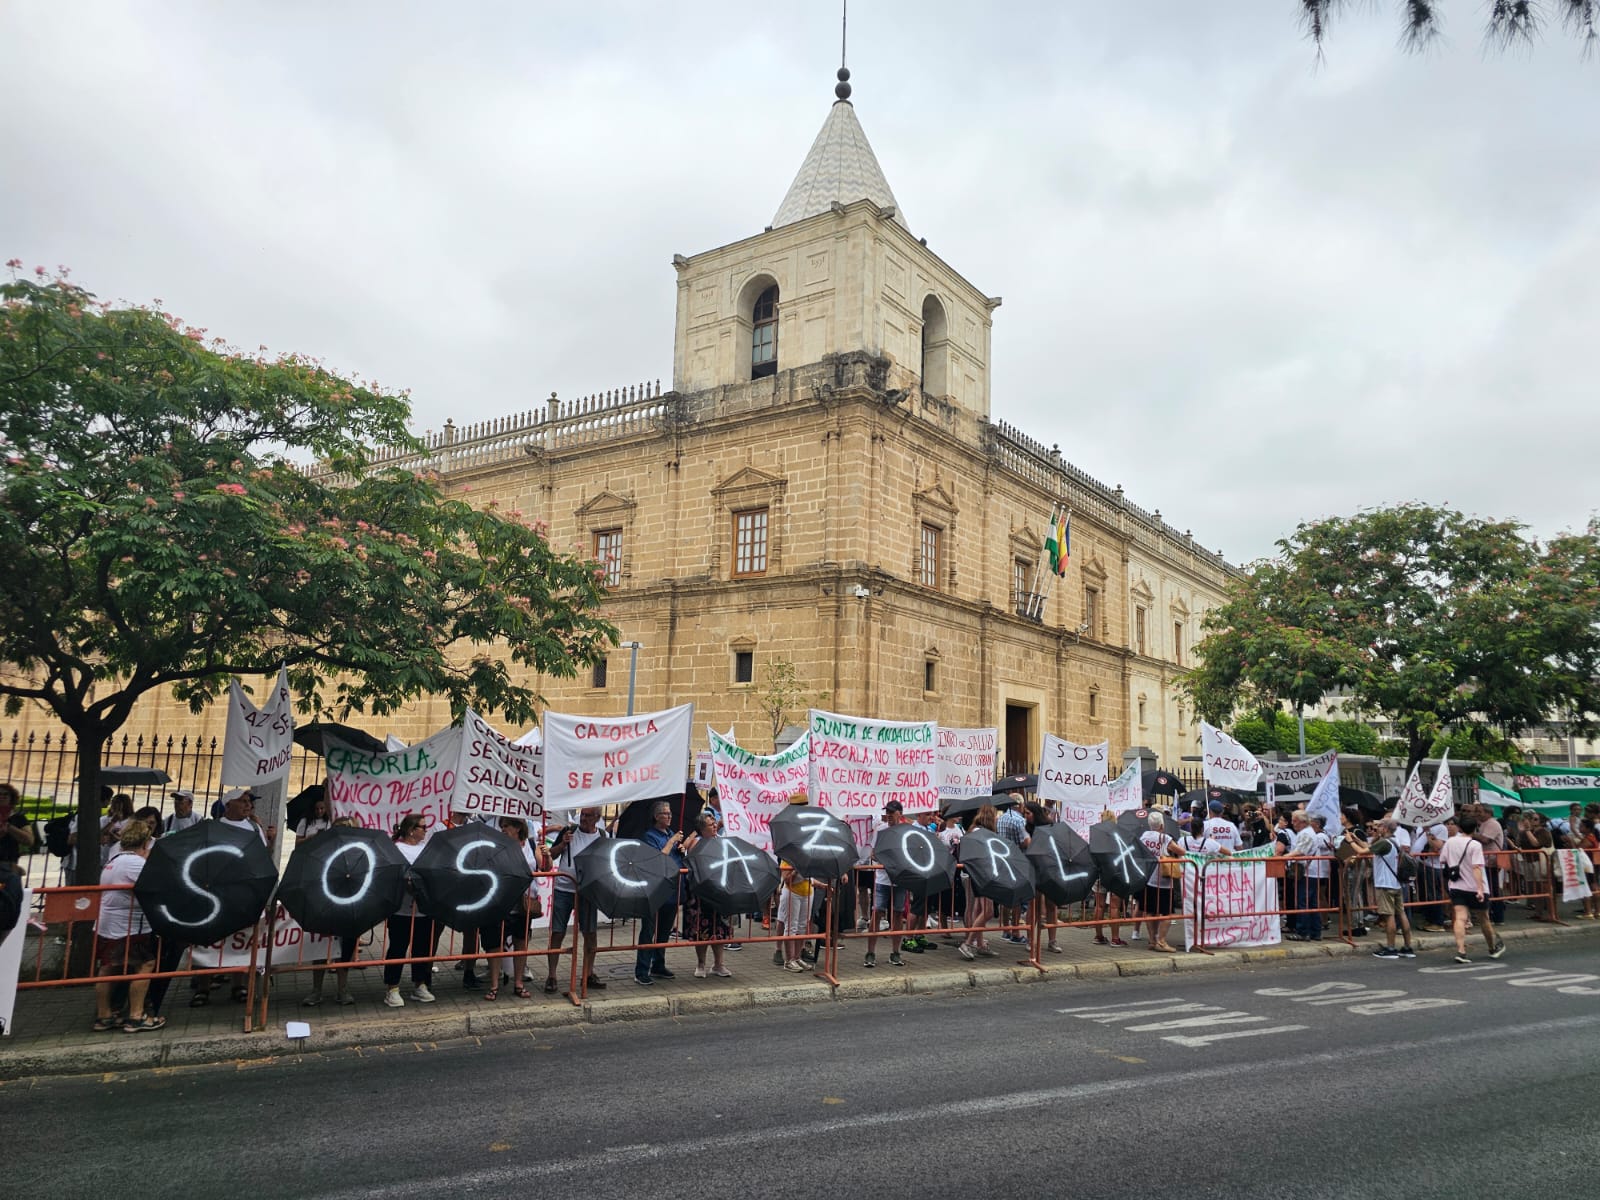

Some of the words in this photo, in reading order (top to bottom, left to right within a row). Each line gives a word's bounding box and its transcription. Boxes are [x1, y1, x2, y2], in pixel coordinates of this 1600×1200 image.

[574, 719, 658, 742] CAZORLA
[813, 717, 857, 739] JUNTA
[862, 726, 873, 740] DE
[470, 740, 493, 760] SE
[604, 750, 629, 768] NO
[874, 749, 889, 766] NO
[896, 748, 935, 766] MERECE
[1206, 753, 1258, 774] CAZORLA
[467, 766, 529, 792] SALUD
[568, 772, 593, 789] SE
[602, 763, 660, 787] RINDE
[832, 768, 873, 787] CENTRO
[877, 770, 890, 786] DE
[895, 770, 929, 788] SALUD
[946, 774, 961, 785] NO
[965, 775, 972, 786] A
[1045, 769, 1108, 787] CAZORLA
[386, 770, 455, 805] PUEBLO
[818, 791, 832, 808] EN
[838, 790, 877, 808] CASCO
[1212, 826, 1231, 834] SOS
[1206, 872, 1253, 896] AZORLA
